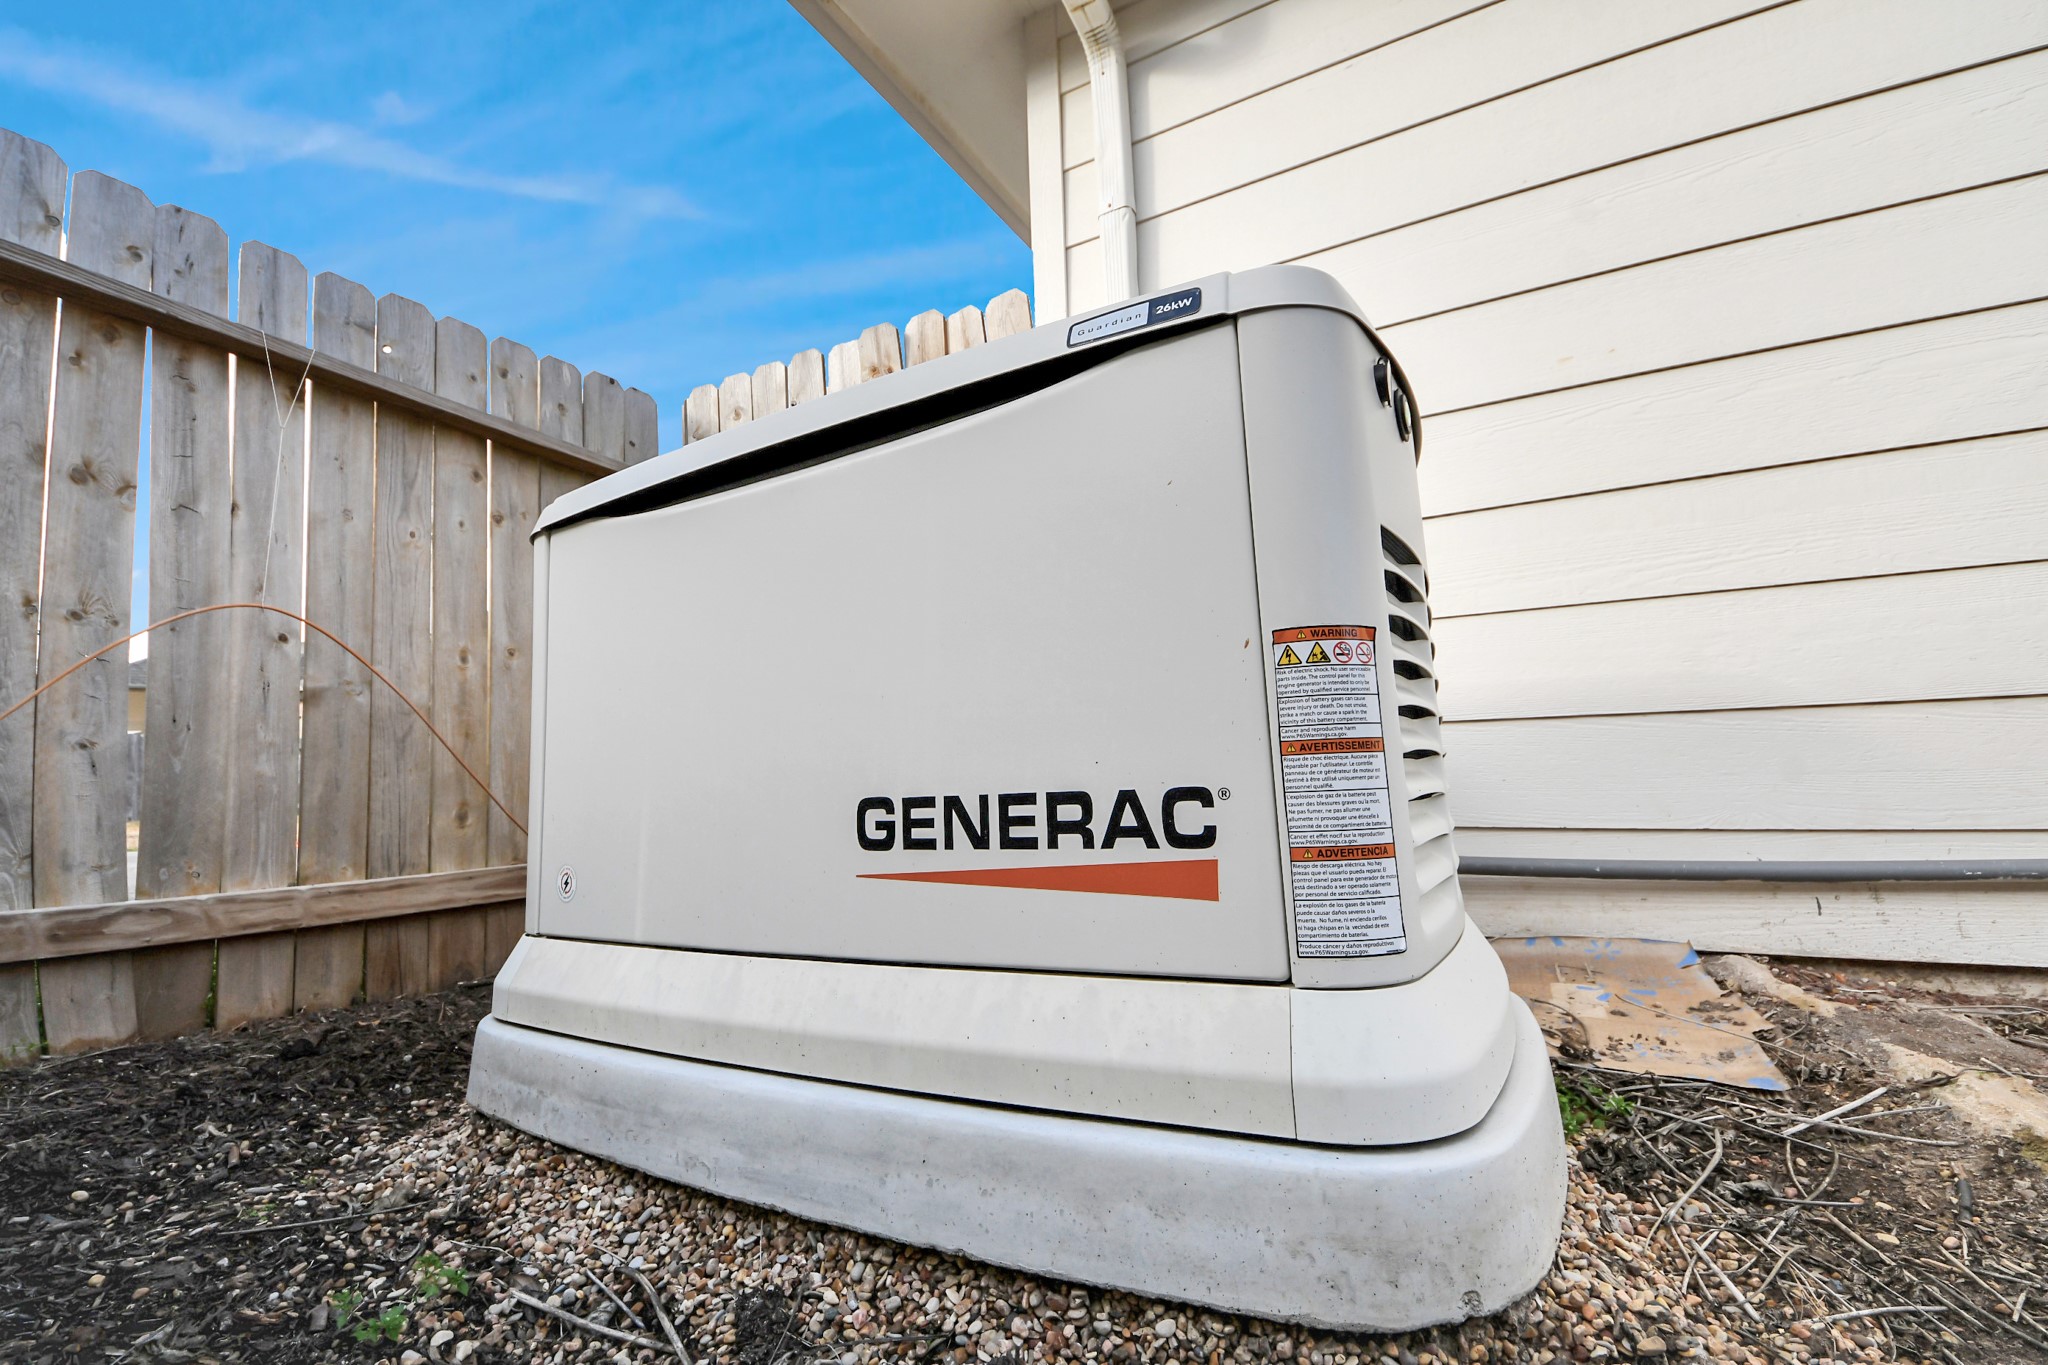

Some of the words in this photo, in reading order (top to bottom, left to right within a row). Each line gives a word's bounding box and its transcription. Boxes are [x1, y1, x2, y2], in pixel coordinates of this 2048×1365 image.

[1077, 313, 1142, 336] Guardian
[1155, 297, 1193, 314] 26kW
[1310, 629, 1358, 637] WARNING
[1300, 740, 1380, 752] AVERTISSEMENT
[1317, 846, 1388, 858] ADVERTENCIA
